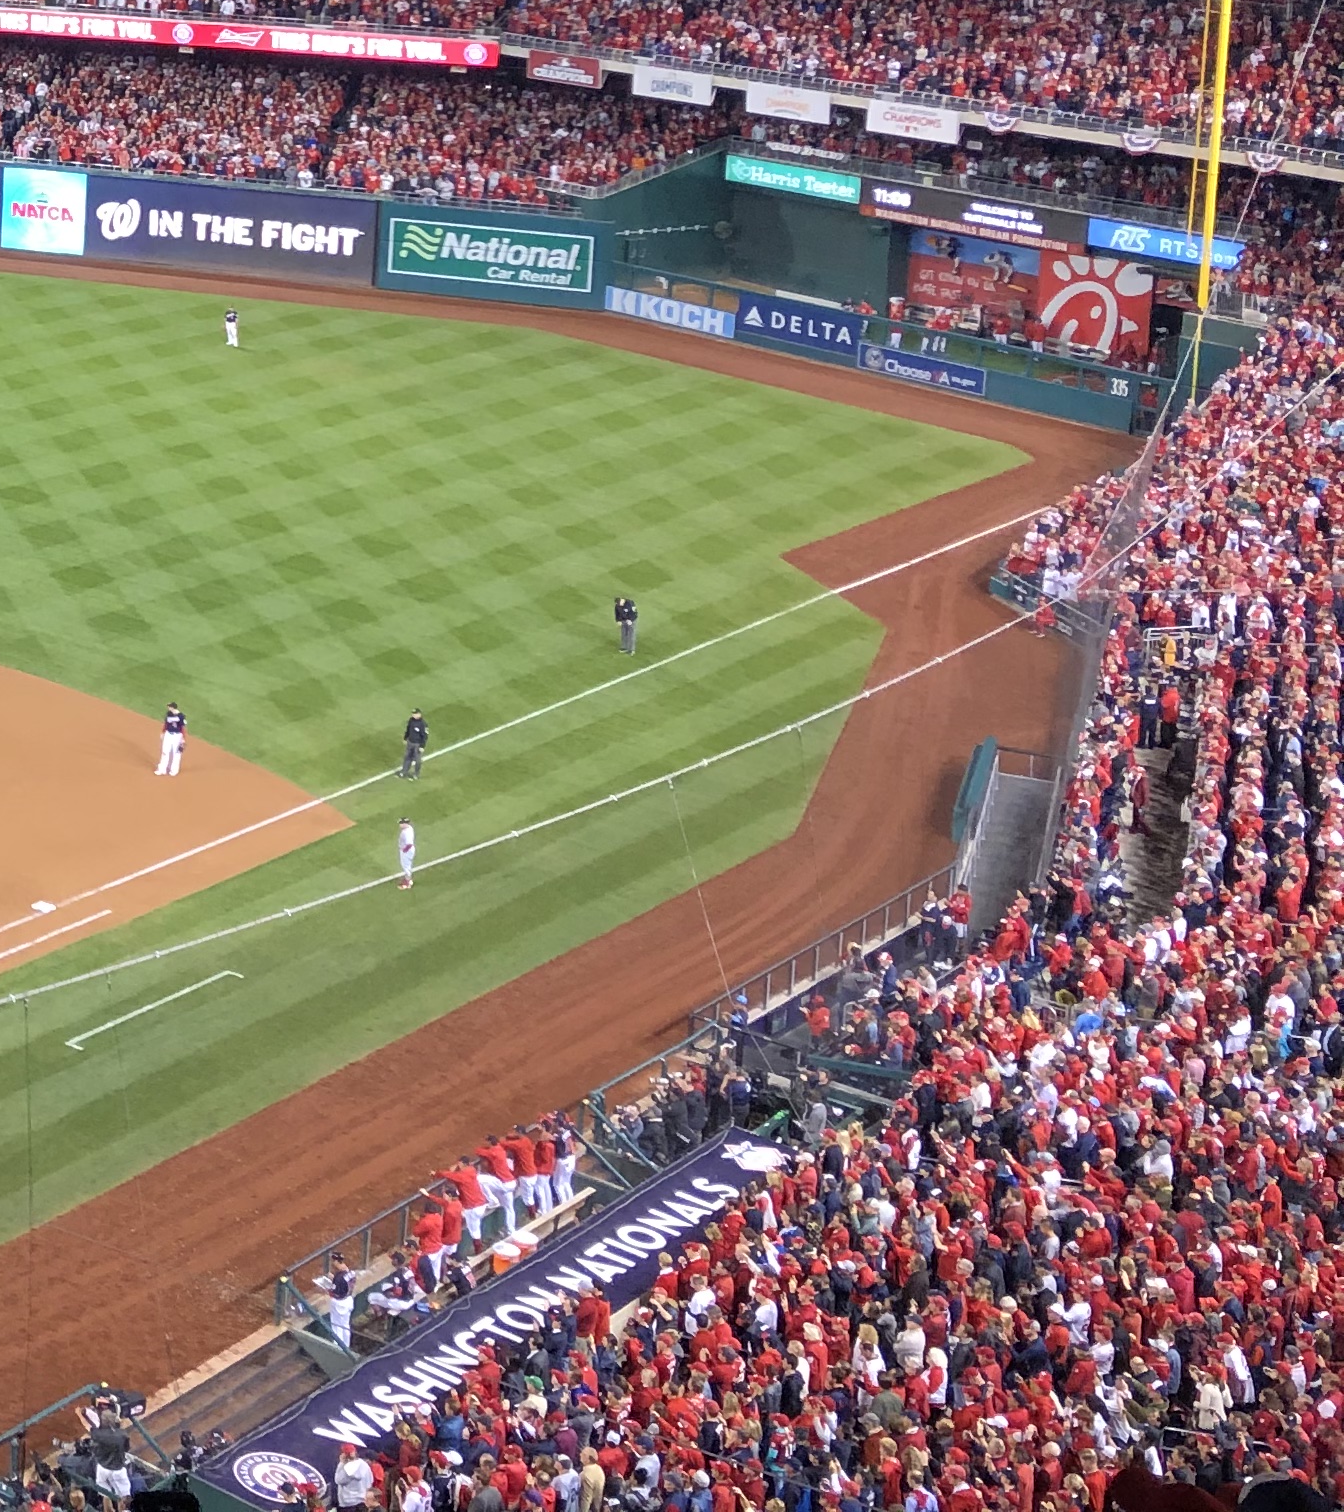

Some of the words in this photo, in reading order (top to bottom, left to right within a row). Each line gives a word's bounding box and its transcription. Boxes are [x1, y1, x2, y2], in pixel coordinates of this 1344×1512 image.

[30, 14, 80, 35] BUD'S
[82, 18, 115, 37] FOR
[118, 20, 156, 40] YOU.
[270, 31, 309, 51] THIS
[311, 33, 365, 55] BUD'S
[367, 37, 402, 57] FOR
[405, 39, 447, 61] YOU.
[882, 111, 943, 130] CHAMPIONS
[750, 166, 801, 189] Harris
[803, 175, 856, 198] Teeter
[11, 201, 75, 224] NATCA
[970, 202, 1019, 219] WELCOME
[1021, 211, 1034, 221] TO
[149, 208, 183, 238] IN
[192, 212, 253, 246] THE
[261, 220, 362, 257] FIGHT
[980, 227, 1010, 241] DREAM
[1012, 234, 1068, 252] FOUNDATION
[1110, 225, 1152, 252] RTS
[439, 230, 576, 272] National
[487, 265, 515, 282] Car
[518, 268, 572, 287] Rental
[637, 293, 727, 336] KOCH
[770, 311, 853, 347] DELTA
[1110, 378, 1129, 398] 335
[313, 1283, 563, 1448] WASHINGTON
[545, 1176, 741, 1299] NATIONALS
